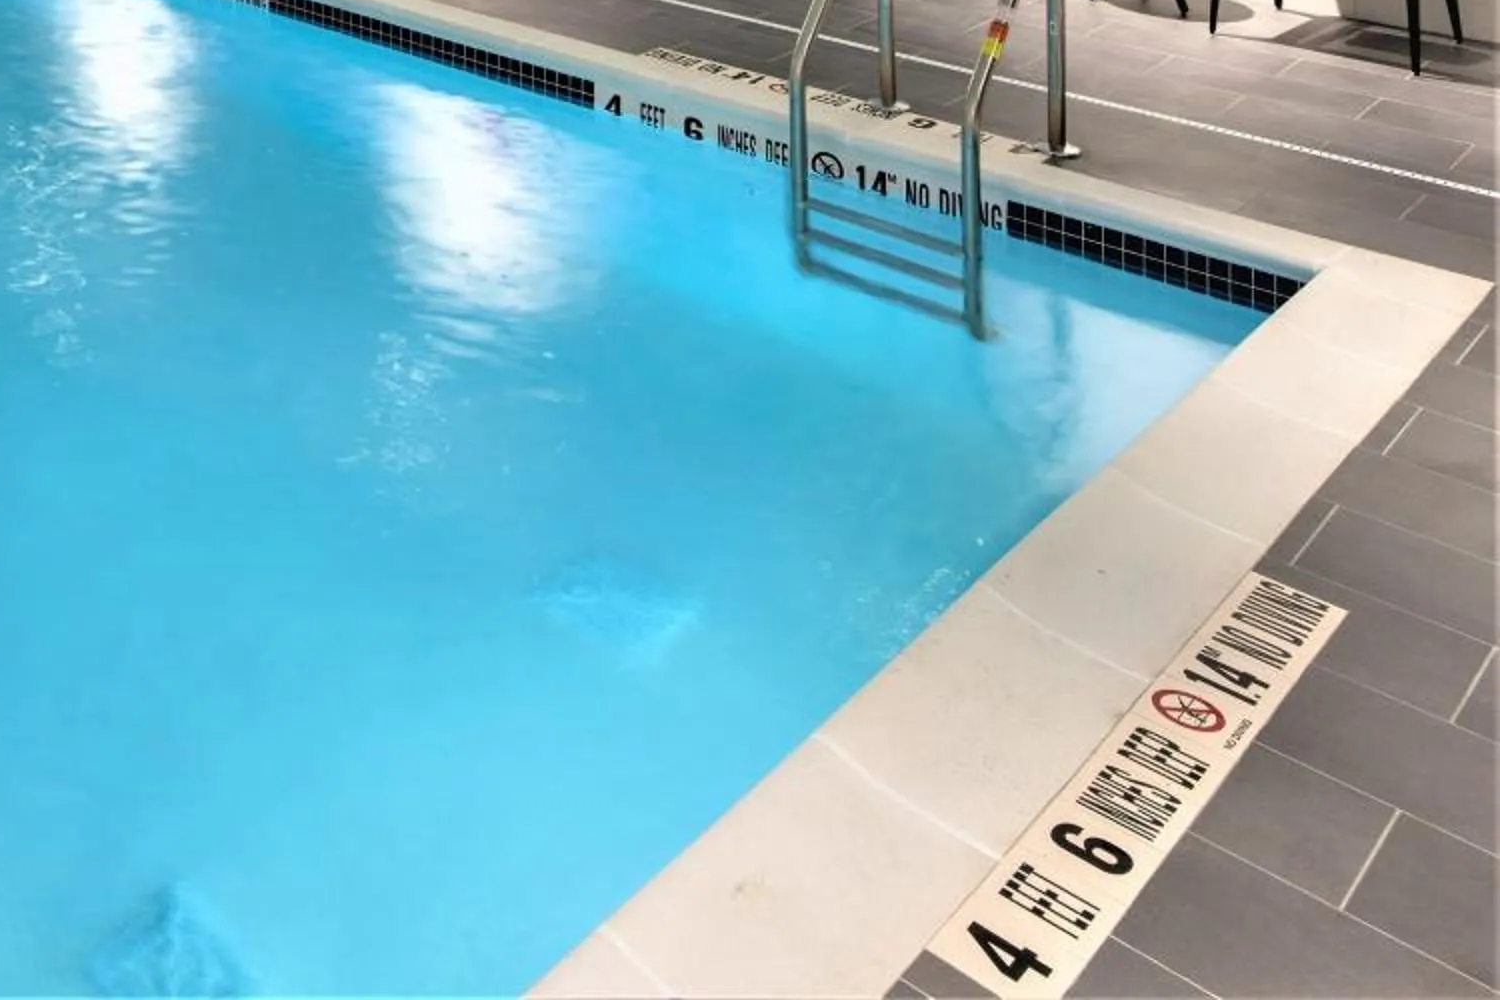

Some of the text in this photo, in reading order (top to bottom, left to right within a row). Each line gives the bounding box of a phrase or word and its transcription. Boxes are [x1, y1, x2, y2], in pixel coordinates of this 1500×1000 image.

[604, 94, 622, 117] 4
[639, 102, 666, 130] FEET
[684, 116, 704, 141] 6
[717, 123, 757, 157] INCHES
[765, 138, 789, 168] DEE
[905, 178, 930, 209] NO
[938, 187, 1003, 232] DING
[1231, 580, 1331, 647] DIVING
[1211, 625, 1293, 671] NO
[1116, 726, 1211, 791] DEEP
[1075, 764, 1183, 843] INCHES
[1050, 822, 1135, 877] 6
[998, 862, 1102, 940] FEET
[967, 921, 1054, 983] 4
